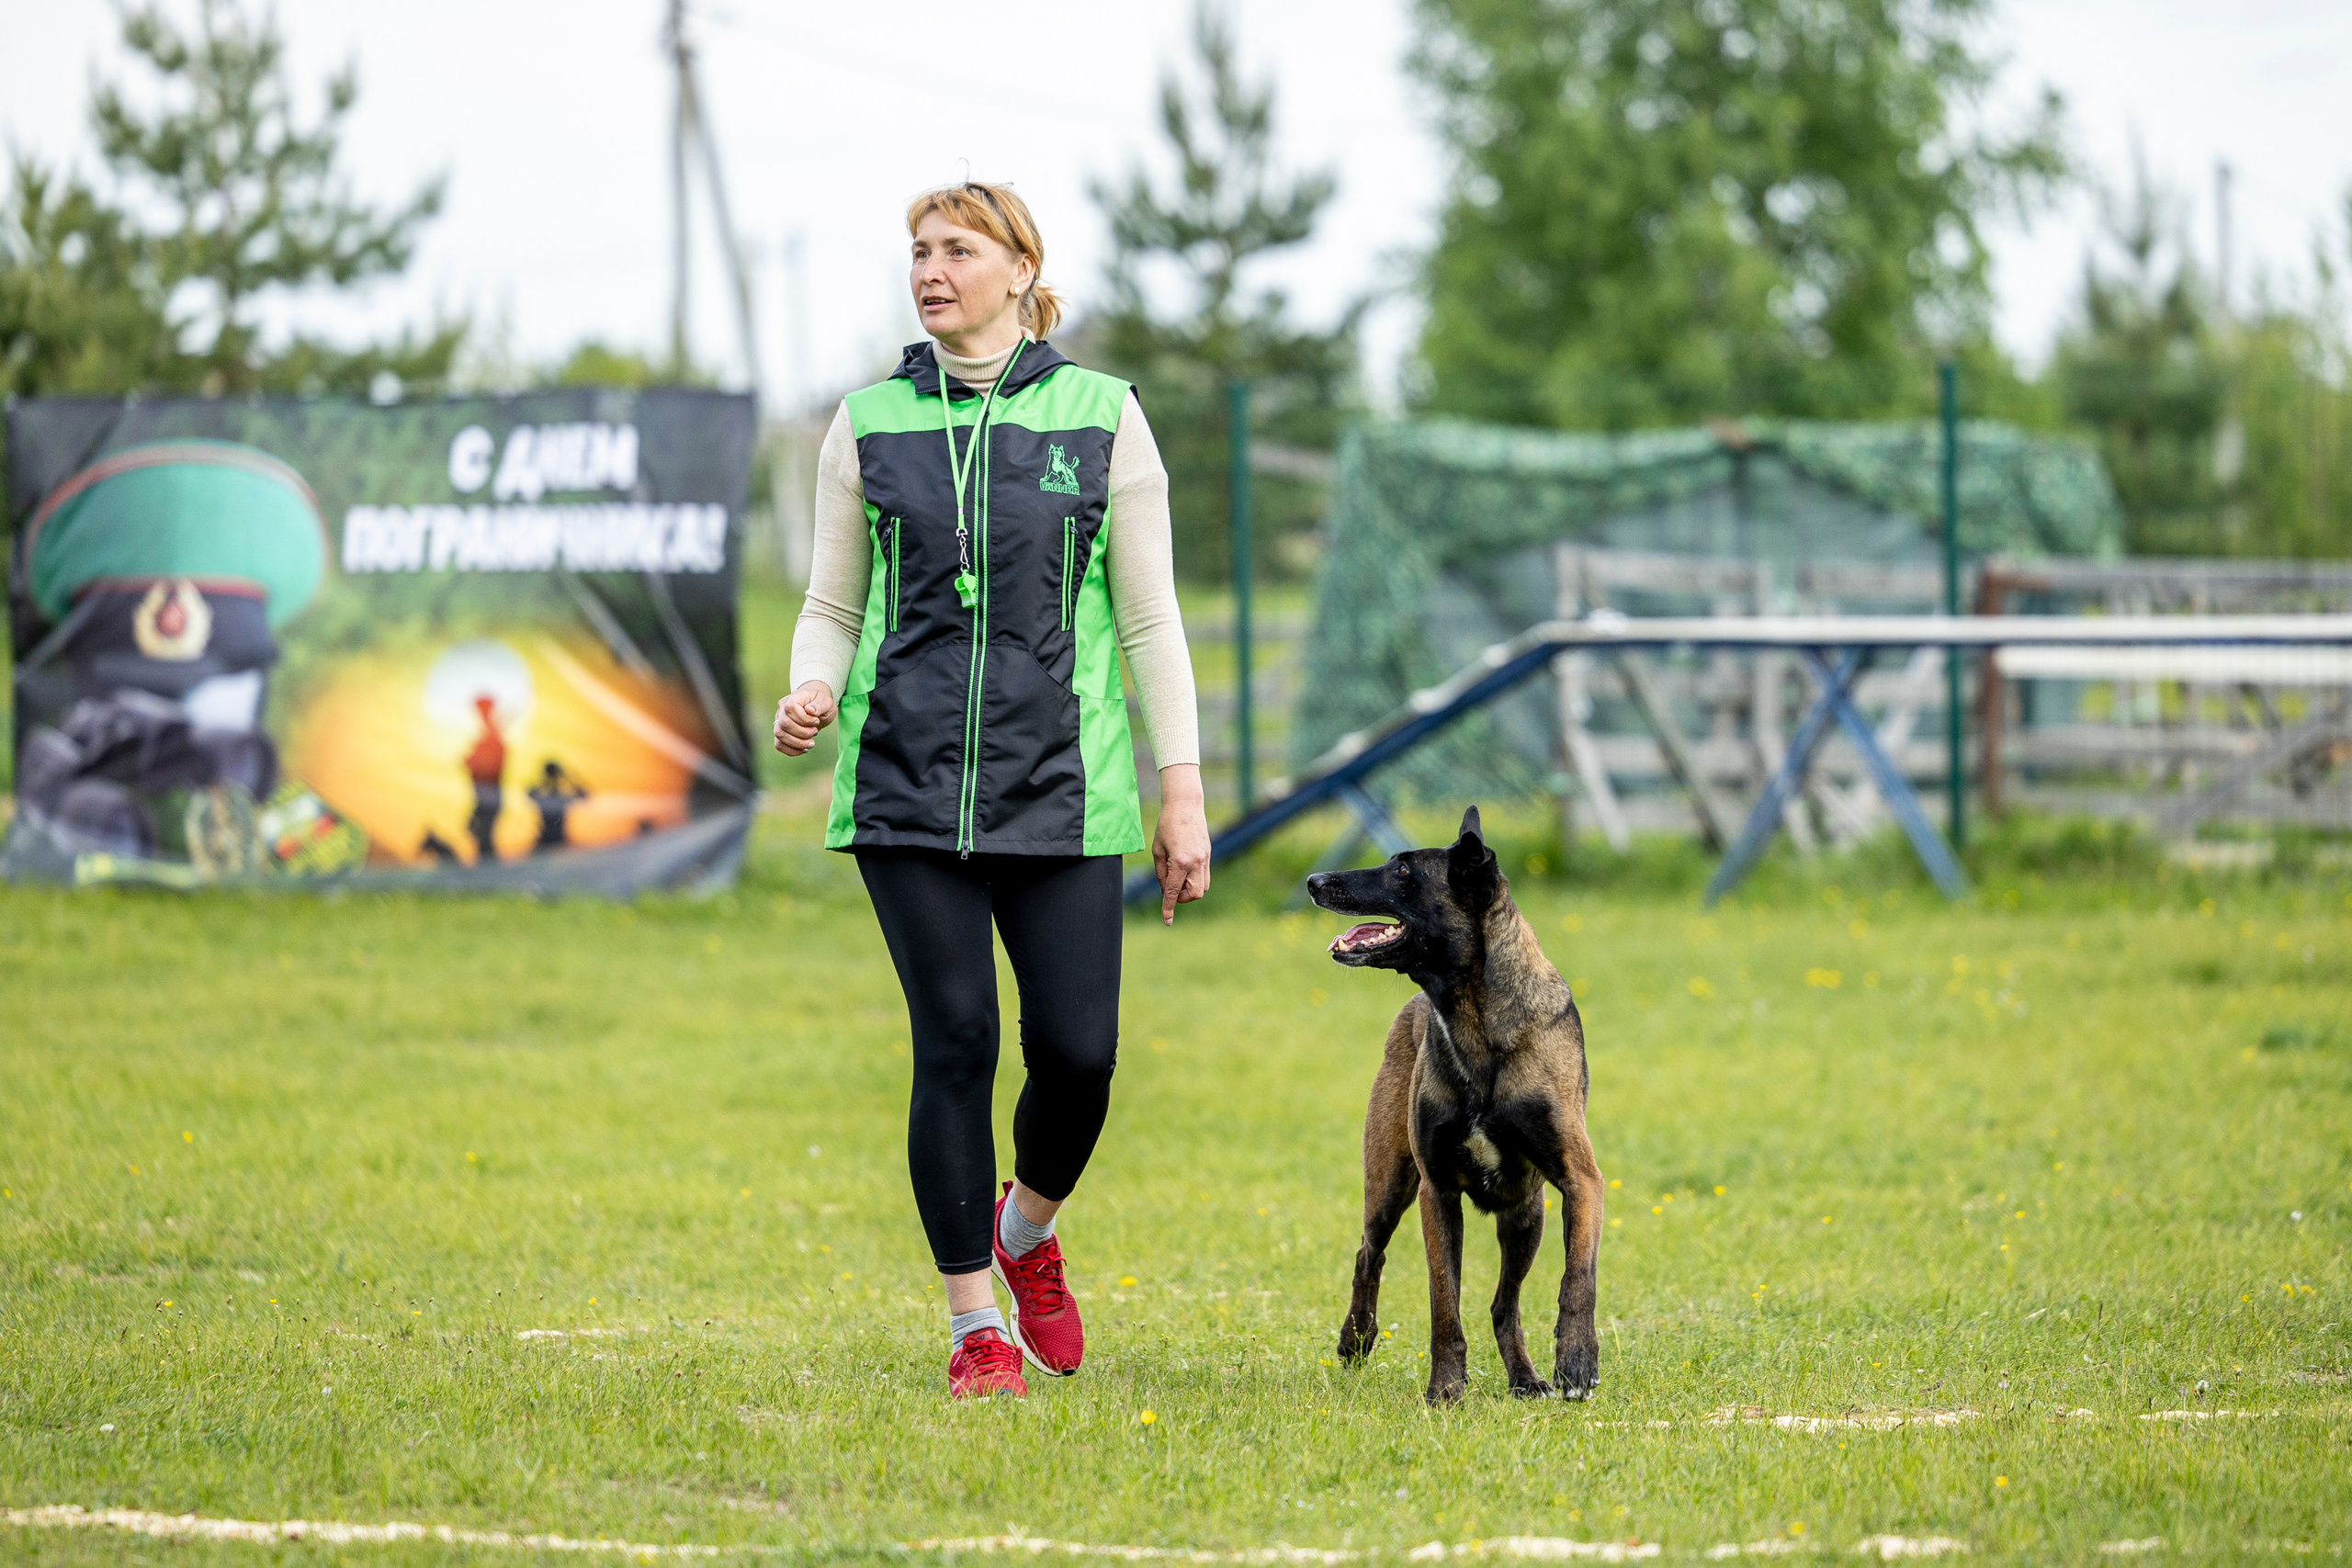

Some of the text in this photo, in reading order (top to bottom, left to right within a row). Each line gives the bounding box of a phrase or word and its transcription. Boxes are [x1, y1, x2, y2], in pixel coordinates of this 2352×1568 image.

[450, 422, 639, 502] С ДНЕМ
[1039, 482, 1080, 495] VANNER
